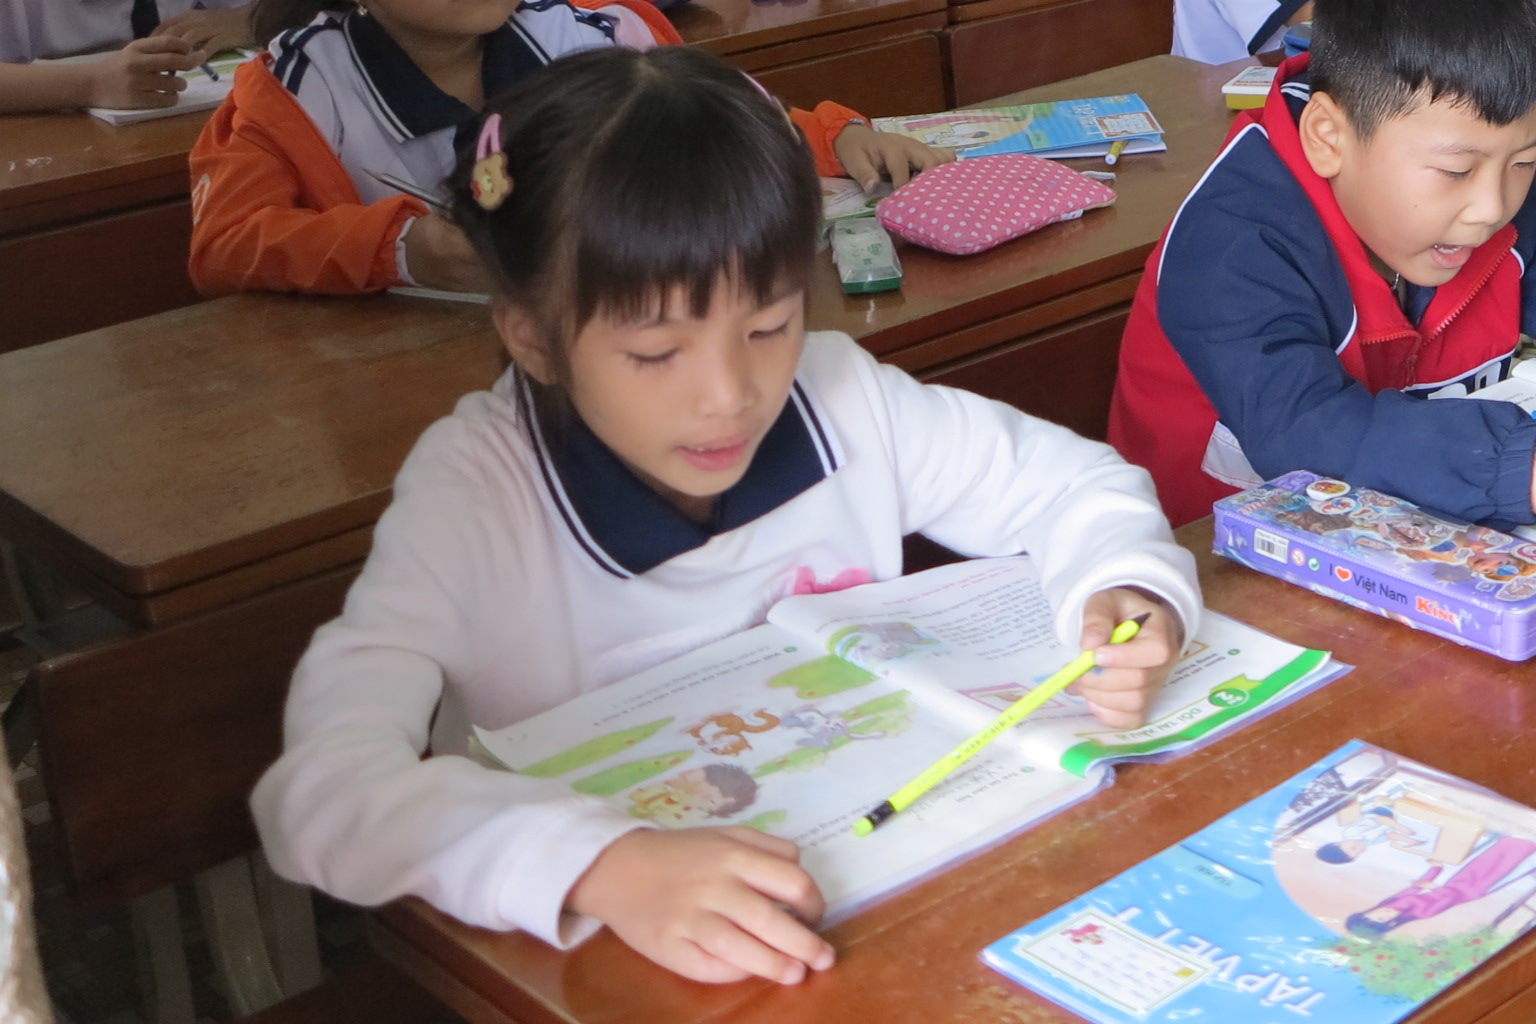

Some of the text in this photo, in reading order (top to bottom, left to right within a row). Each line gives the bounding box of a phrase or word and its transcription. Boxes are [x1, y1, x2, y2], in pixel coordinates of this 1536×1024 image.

[1353, 573, 1377, 594] Việt
[1379, 585, 1408, 605] Nam
[1235, 974, 1326, 1016] TẬP
